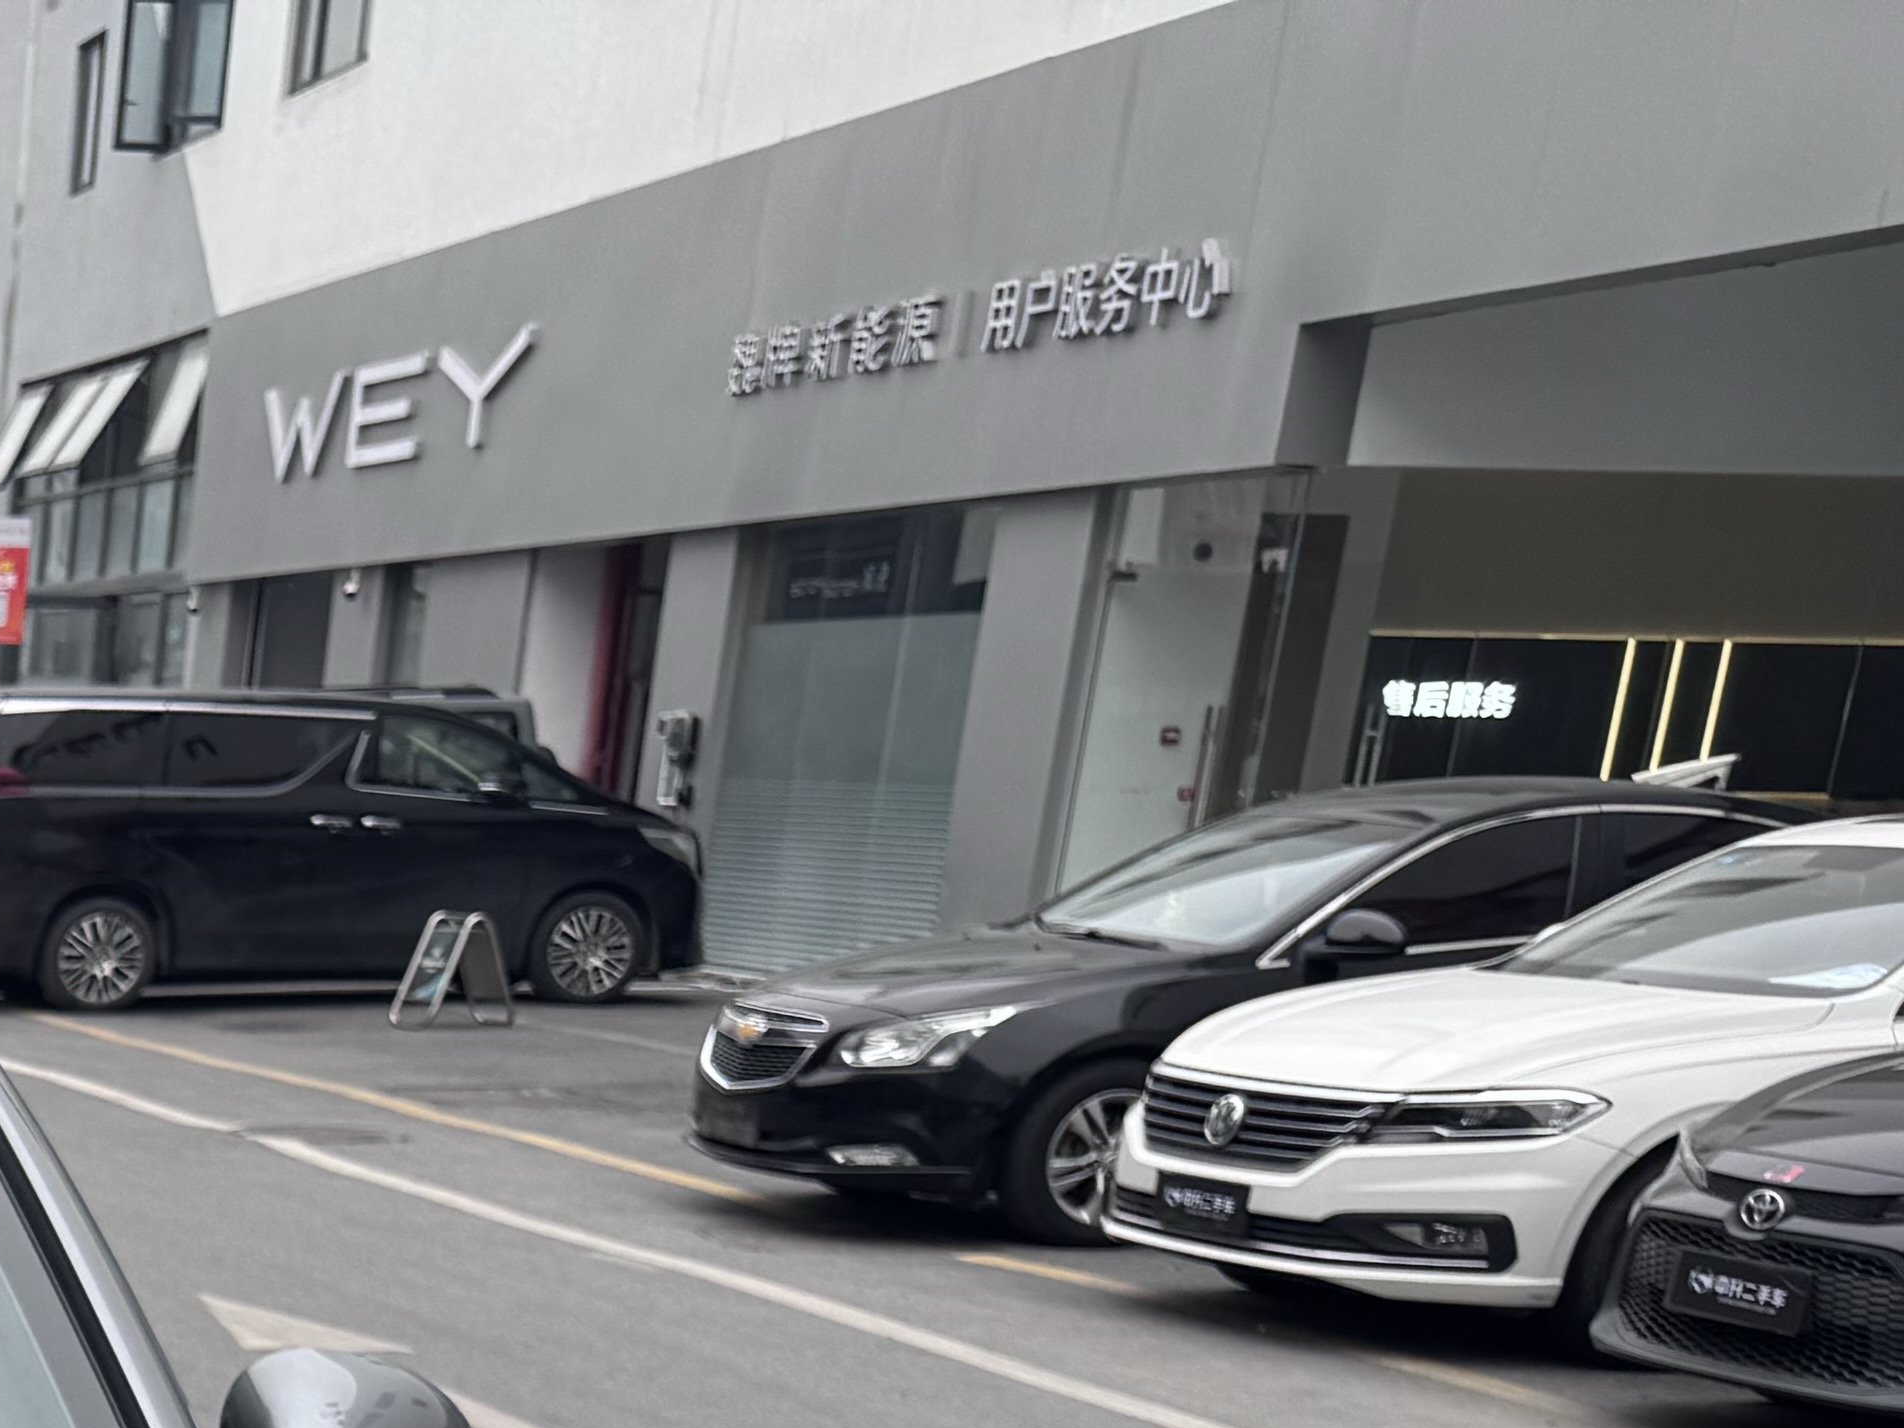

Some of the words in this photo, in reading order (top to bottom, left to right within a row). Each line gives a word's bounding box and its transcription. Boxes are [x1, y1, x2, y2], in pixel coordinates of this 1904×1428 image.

[981, 238, 1231, 352] 用户服务中心
[264, 322, 540, 483] WEY
[1382, 680, 1517, 719] 售后服务
